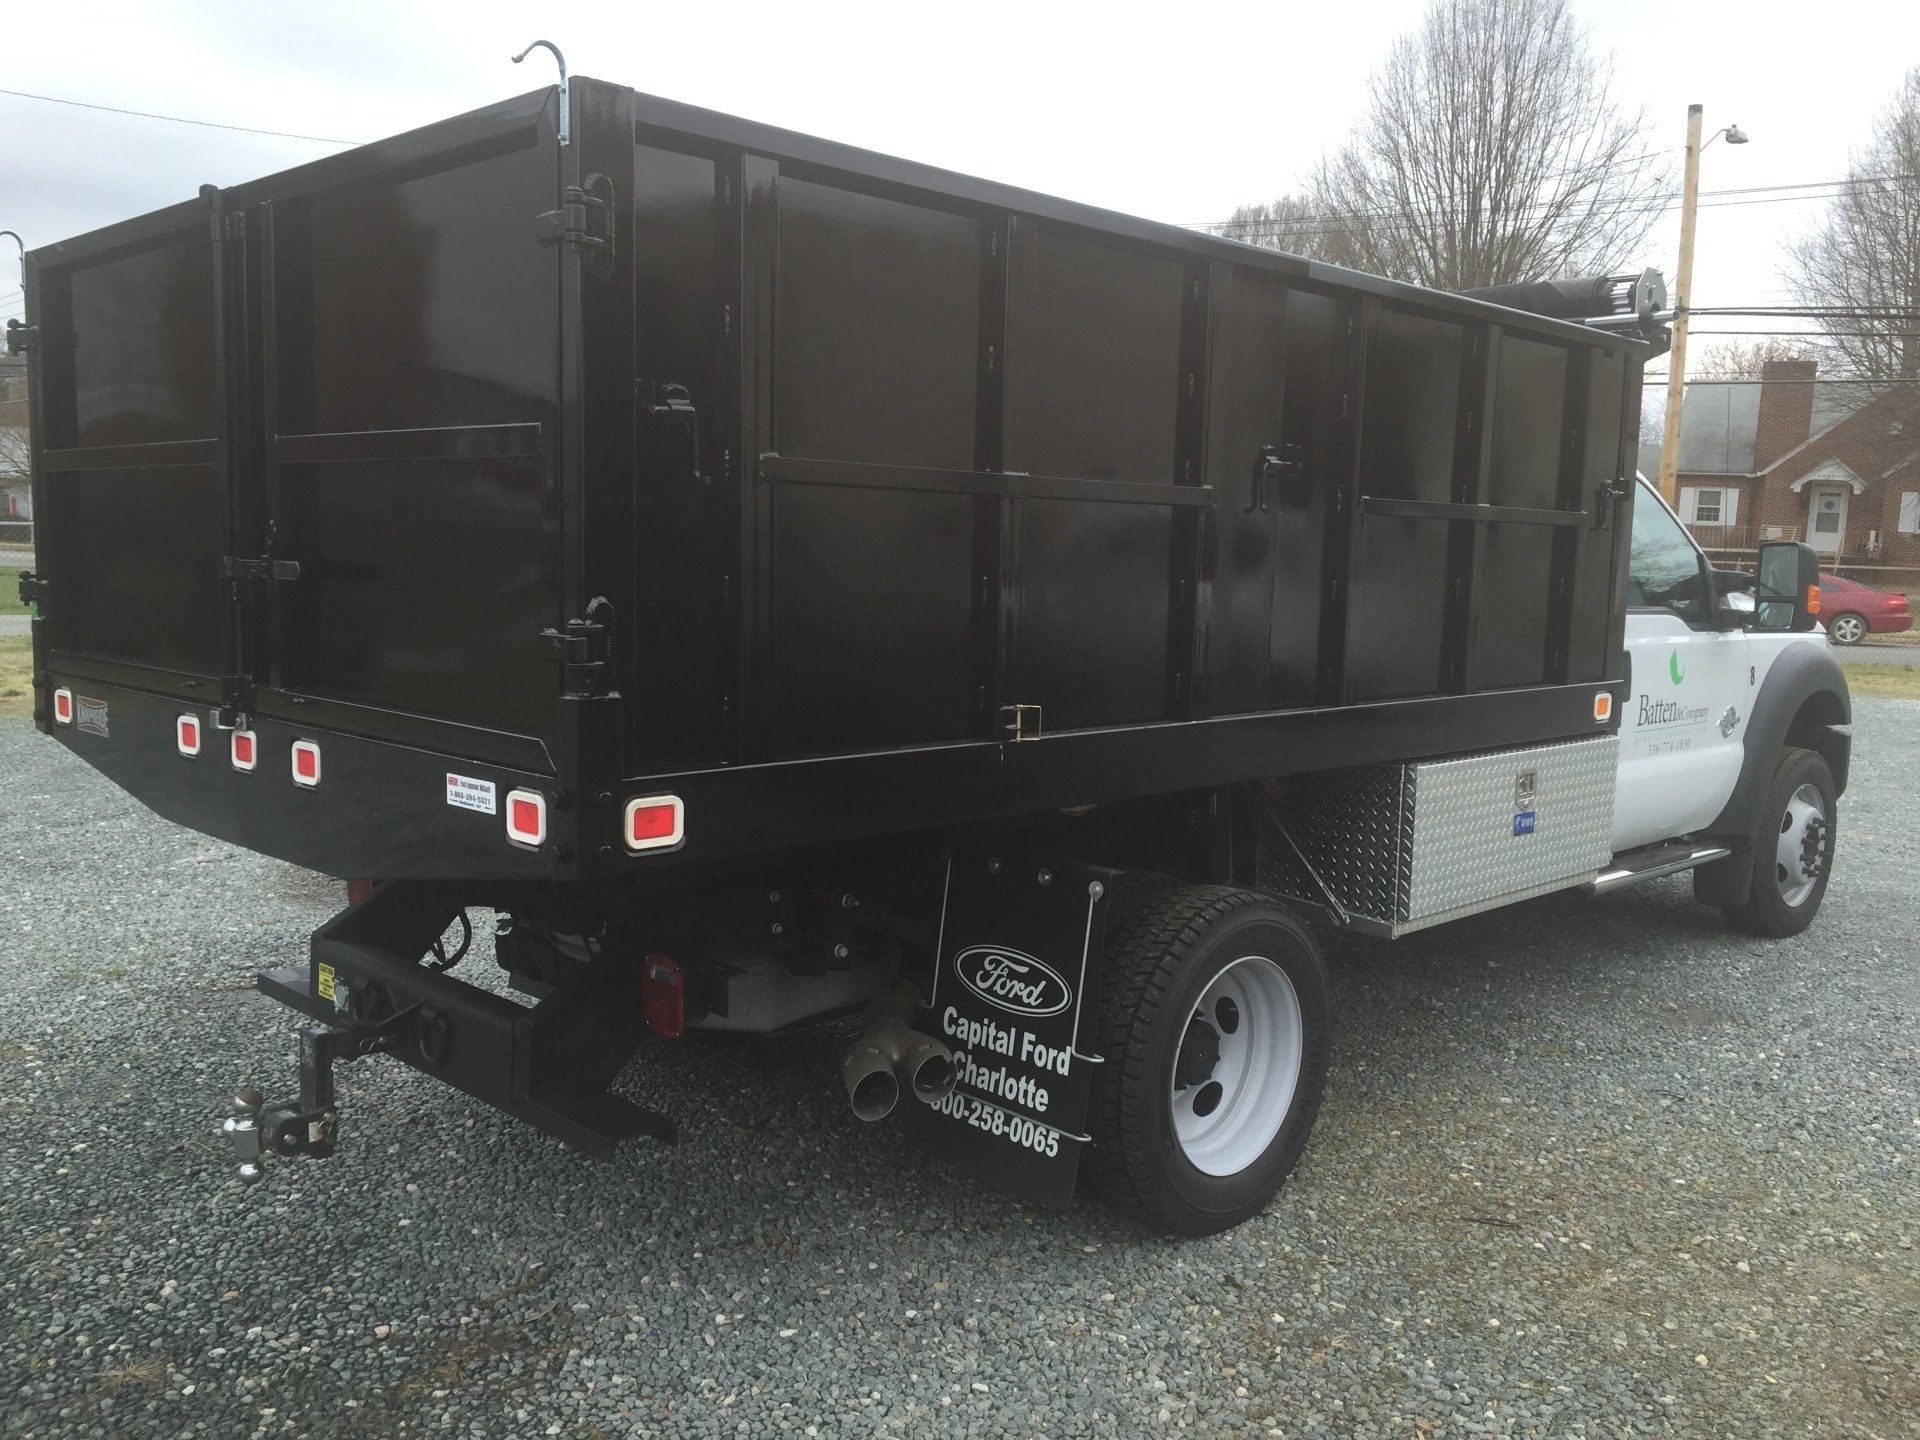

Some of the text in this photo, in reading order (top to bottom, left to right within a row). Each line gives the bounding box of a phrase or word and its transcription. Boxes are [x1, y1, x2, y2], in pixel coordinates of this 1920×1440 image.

[975, 955, 1047, 1007] Ford
[943, 1006, 1072, 1077] Capital Ford
[952, 1050, 1050, 1113] Charlotte
